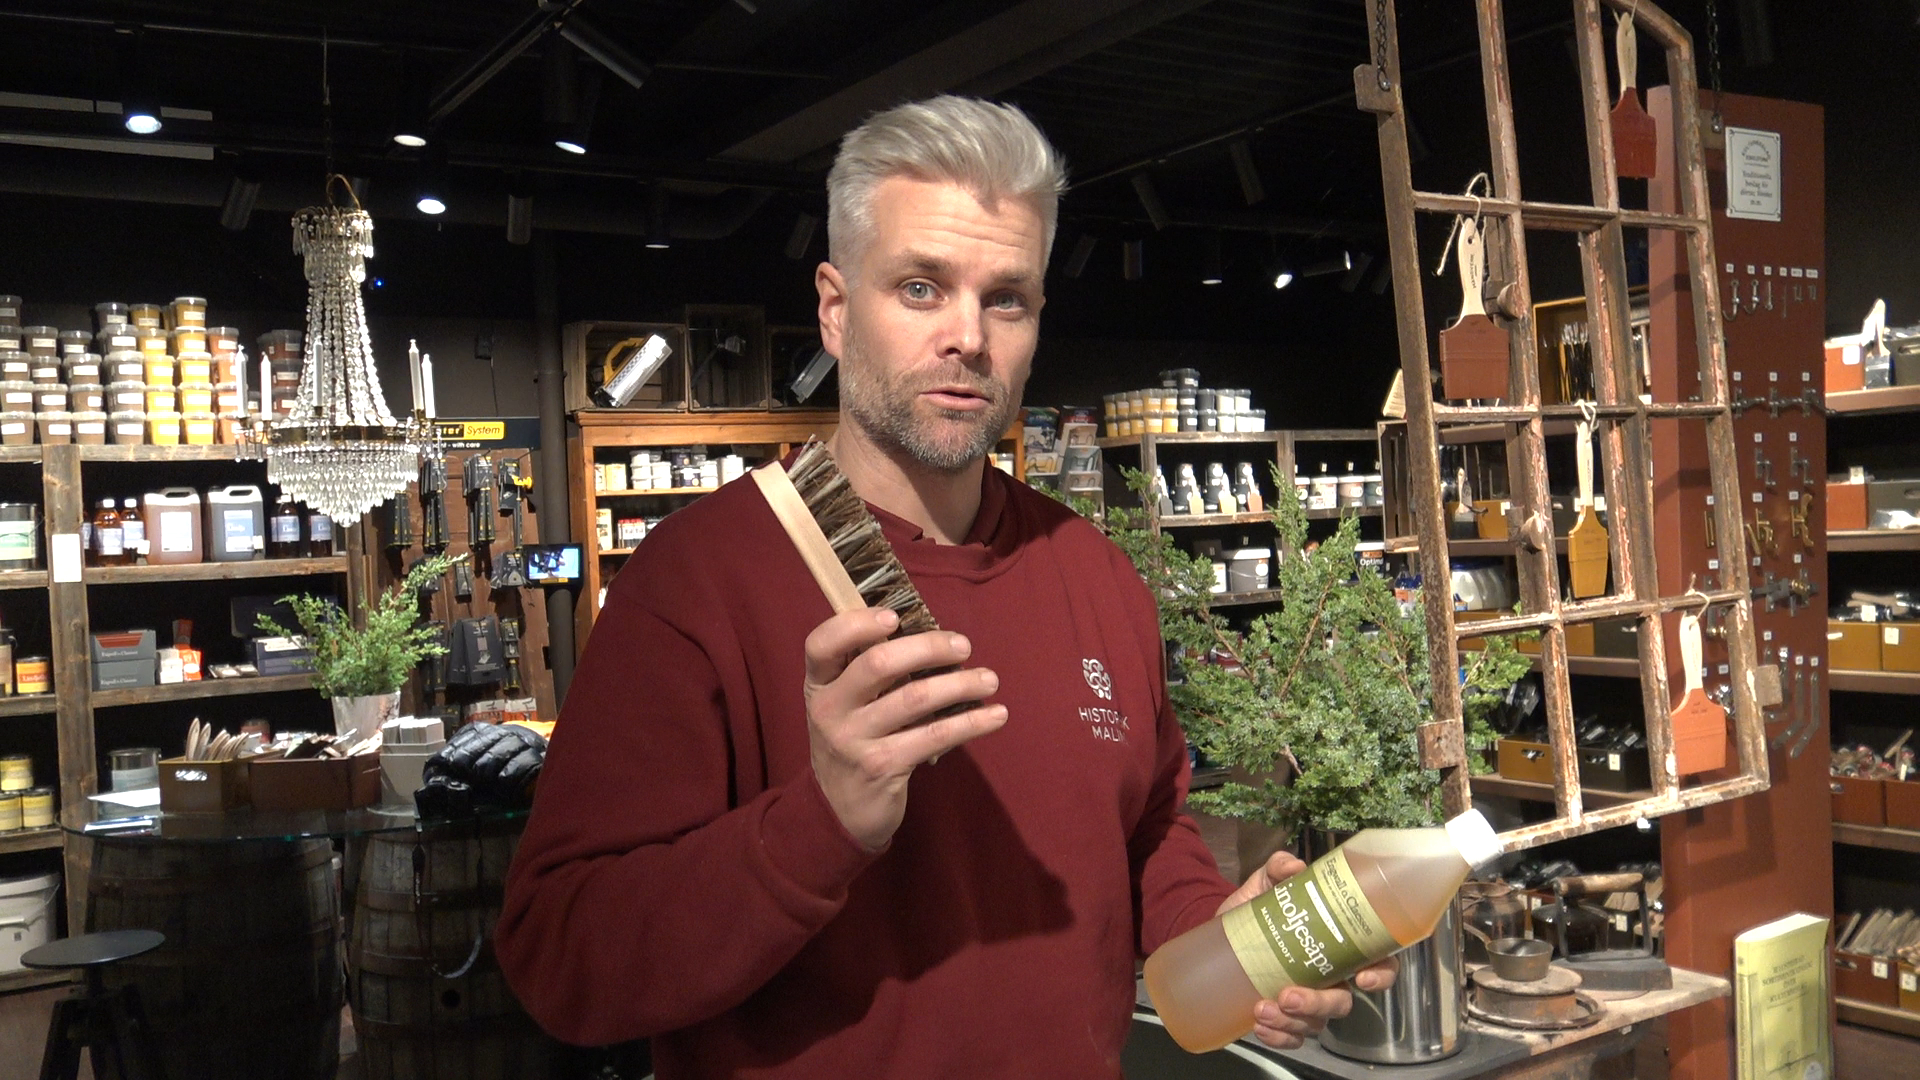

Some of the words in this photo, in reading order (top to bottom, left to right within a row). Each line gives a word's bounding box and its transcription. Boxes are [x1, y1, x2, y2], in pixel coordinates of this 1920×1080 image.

[467, 425, 500, 436] System
[1078, 706, 1130, 730] HISTORK
[1092, 725, 1127, 744] MALIN
[1260, 906, 1296, 964] MANDELDOFT
